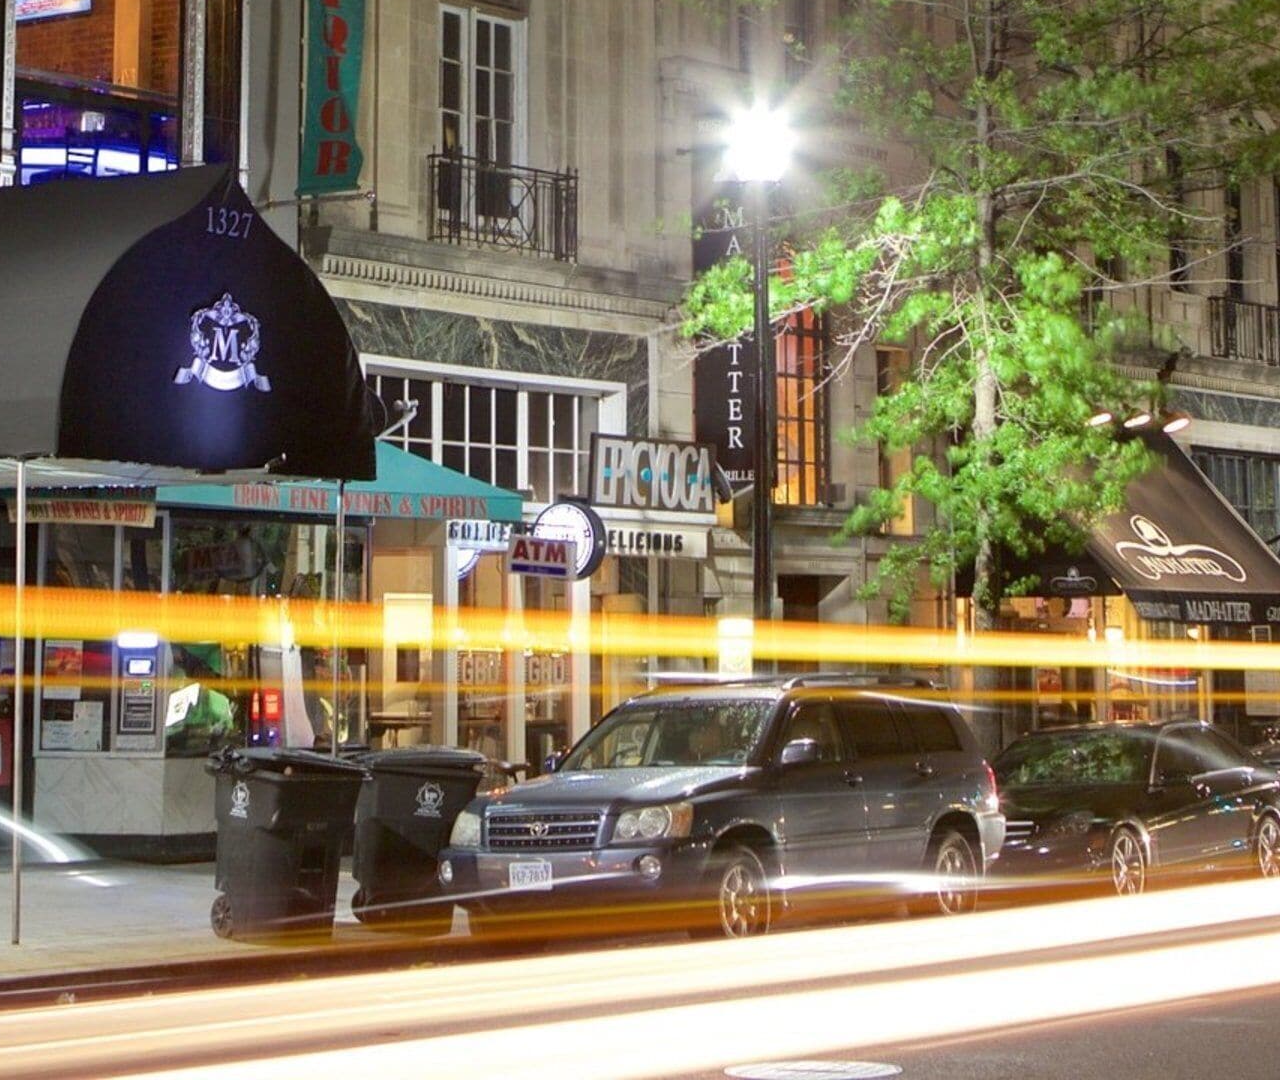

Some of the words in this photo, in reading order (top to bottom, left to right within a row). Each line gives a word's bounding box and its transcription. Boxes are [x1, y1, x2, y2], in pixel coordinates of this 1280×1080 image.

[206, 206, 253, 239] 1327
[208, 326, 241, 366] M
[723, 470, 754, 481] RILLE
[233, 483, 280, 506] CROWN
[289, 488, 329, 512] FINE
[399, 496, 412, 515] &
[422, 496, 488, 518] SPIRITS
[448, 521, 510, 543] GOLDE
[607, 530, 682, 553] ELICIOUS
[513, 539, 567, 563] ATM
[1185, 600, 1251, 623] MADHATTER
